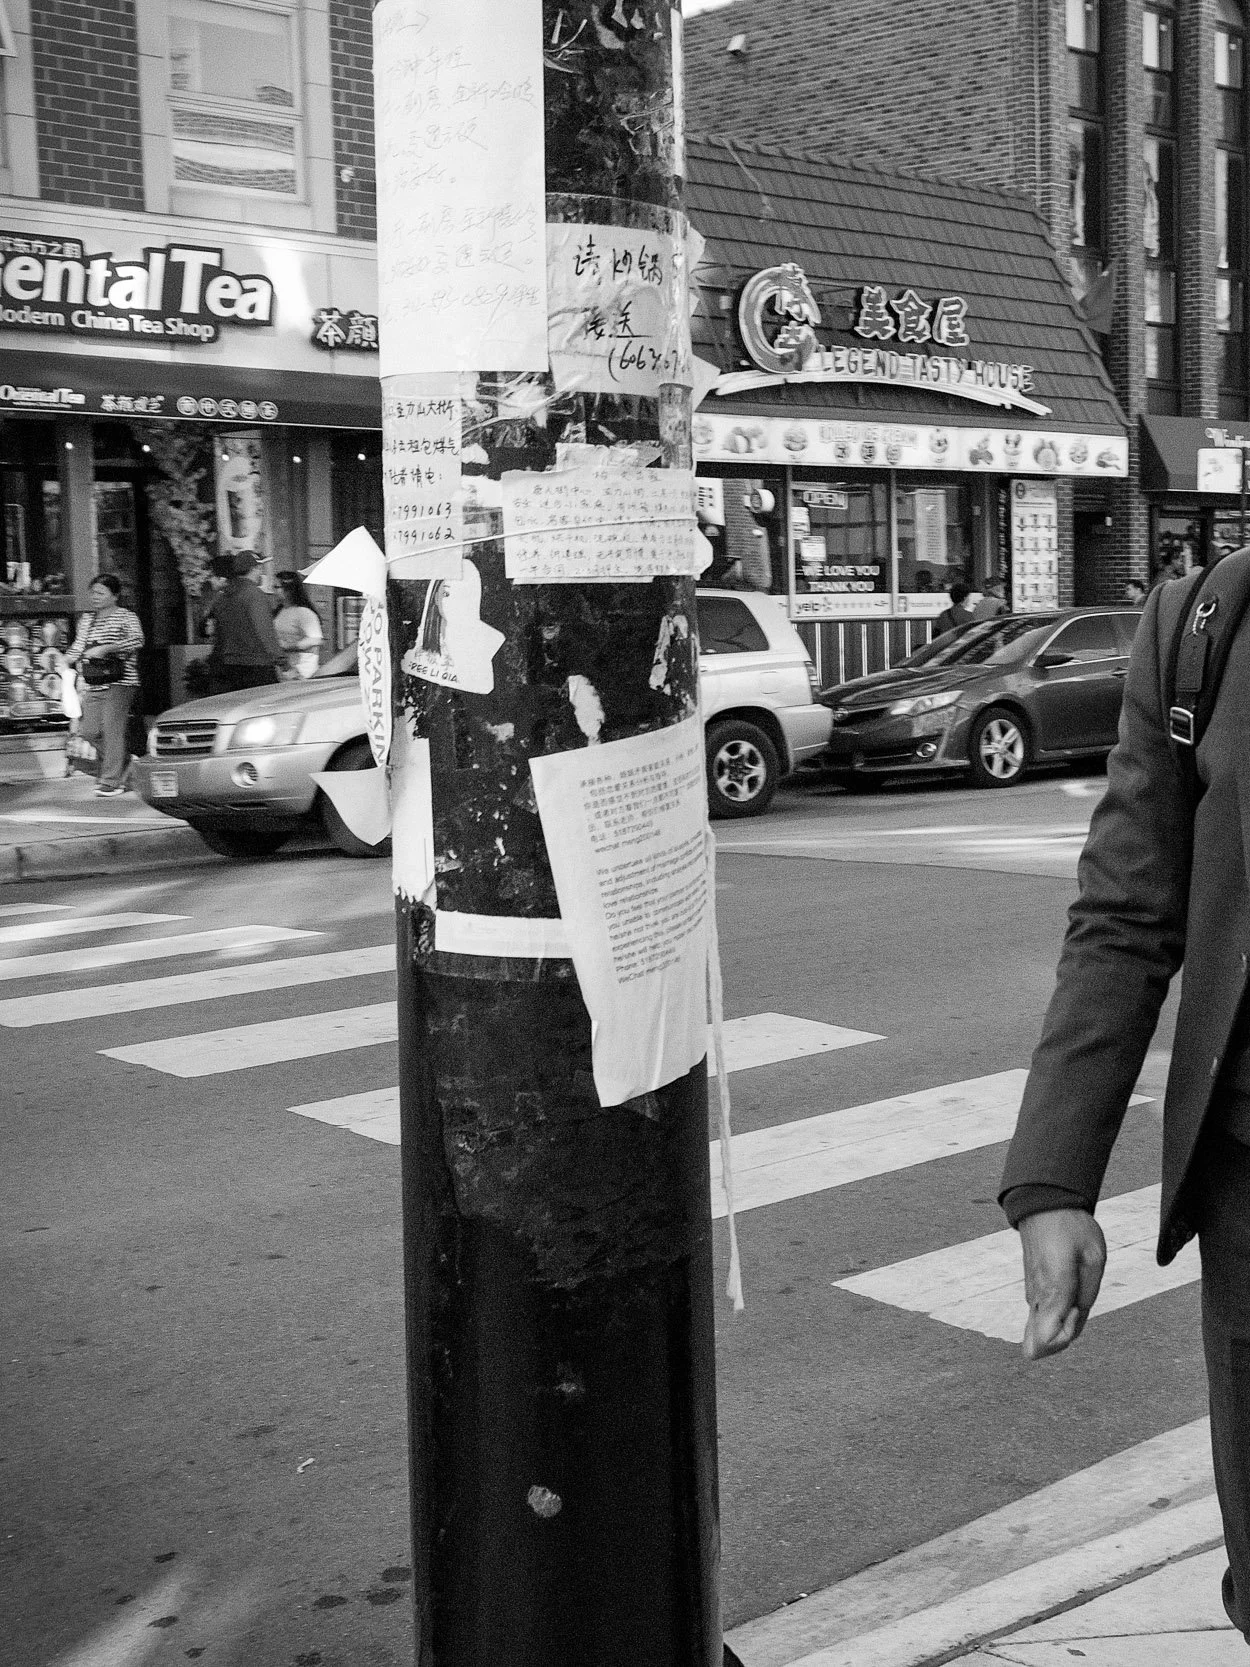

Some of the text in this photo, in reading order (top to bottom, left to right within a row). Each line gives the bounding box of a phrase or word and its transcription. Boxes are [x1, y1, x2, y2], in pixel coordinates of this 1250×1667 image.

[0, 248, 271, 320] ental Tea
[0, 304, 215, 342] odern China Tea Shop
[822, 345, 1035, 392] LEGEND TASTY HOUSE
